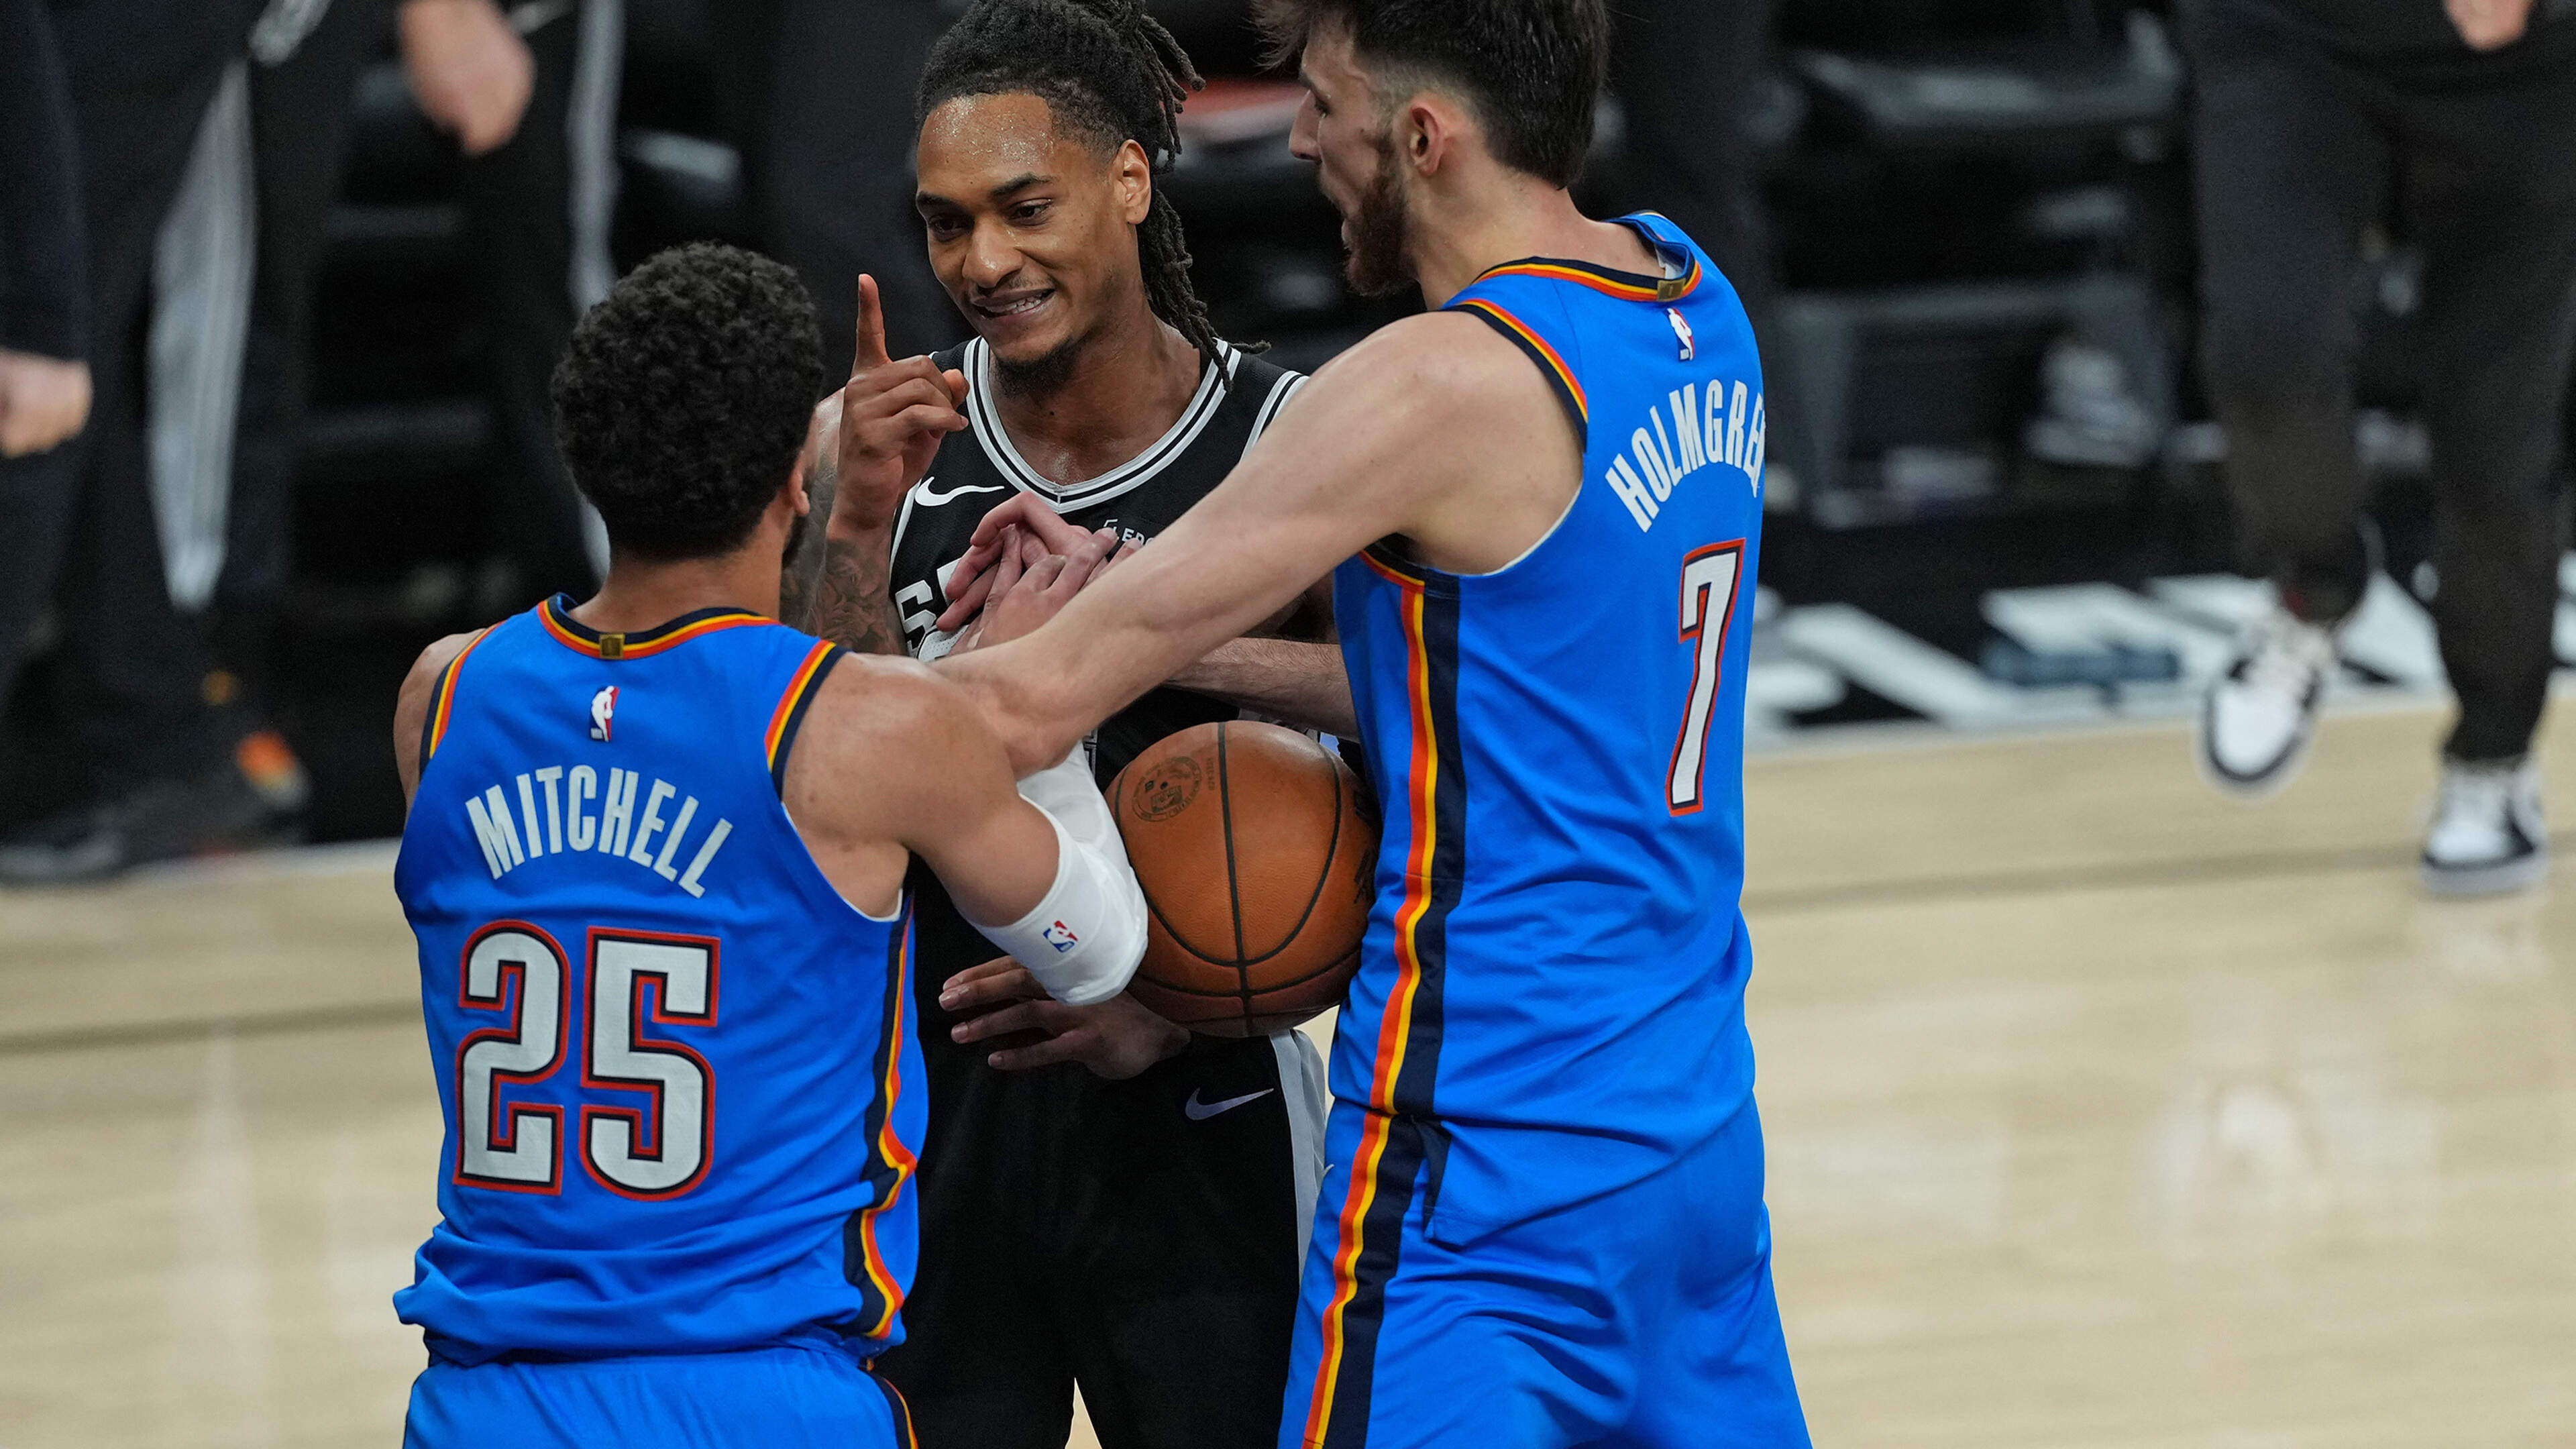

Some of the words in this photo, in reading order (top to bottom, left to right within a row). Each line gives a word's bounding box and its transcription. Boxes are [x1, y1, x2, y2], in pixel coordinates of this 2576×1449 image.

[1665, 539, 1746, 816] 7
[466, 764, 732, 898] MITCHELL
[453, 920, 720, 1201] 25
